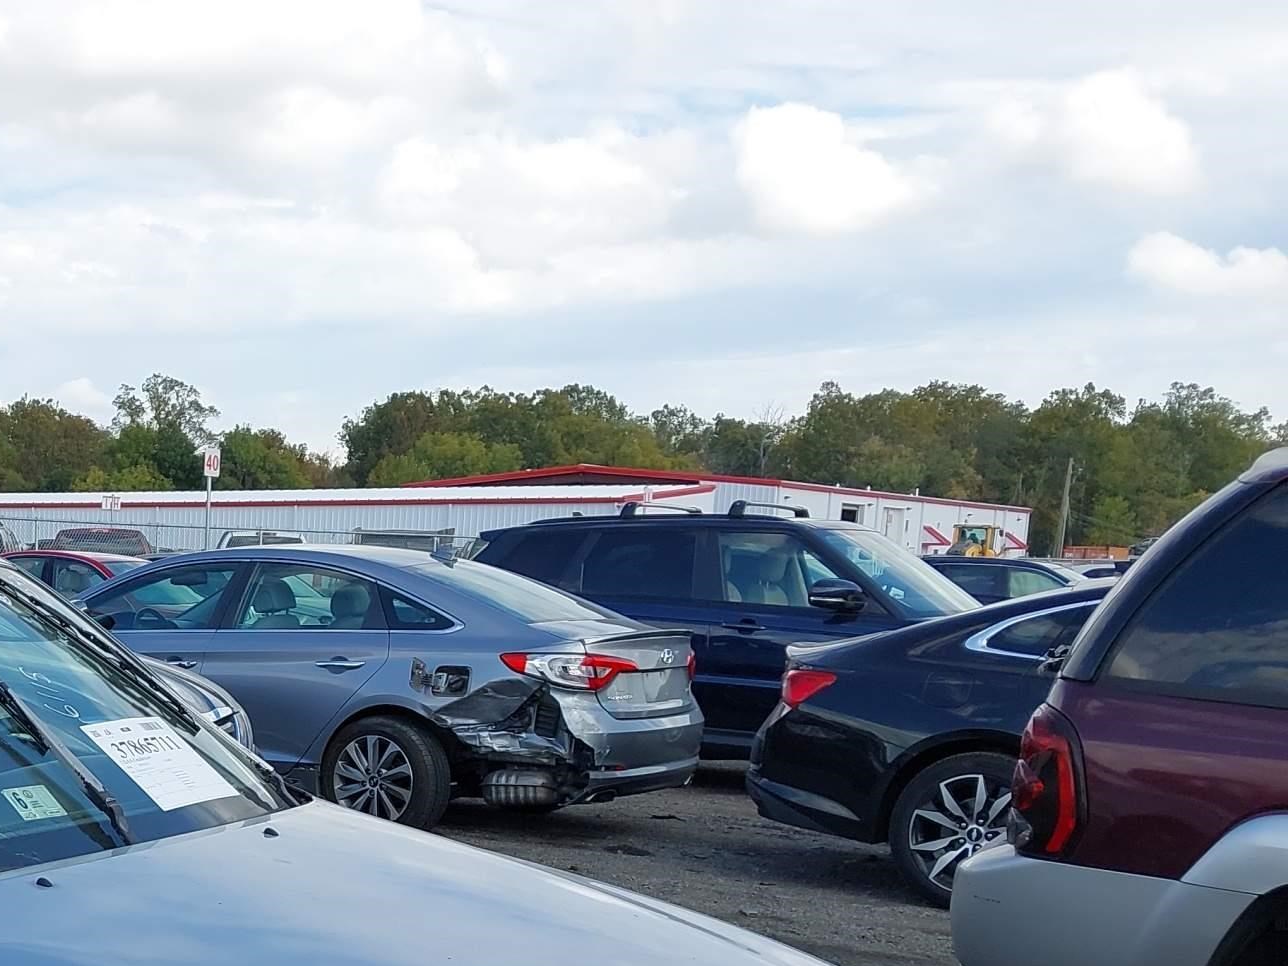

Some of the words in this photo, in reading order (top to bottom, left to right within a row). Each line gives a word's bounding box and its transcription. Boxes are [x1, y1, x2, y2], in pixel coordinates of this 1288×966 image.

[206, 454, 219, 472] 40
[111, 735, 182, 759] 37865711
[12, 792, 29, 810] 6
